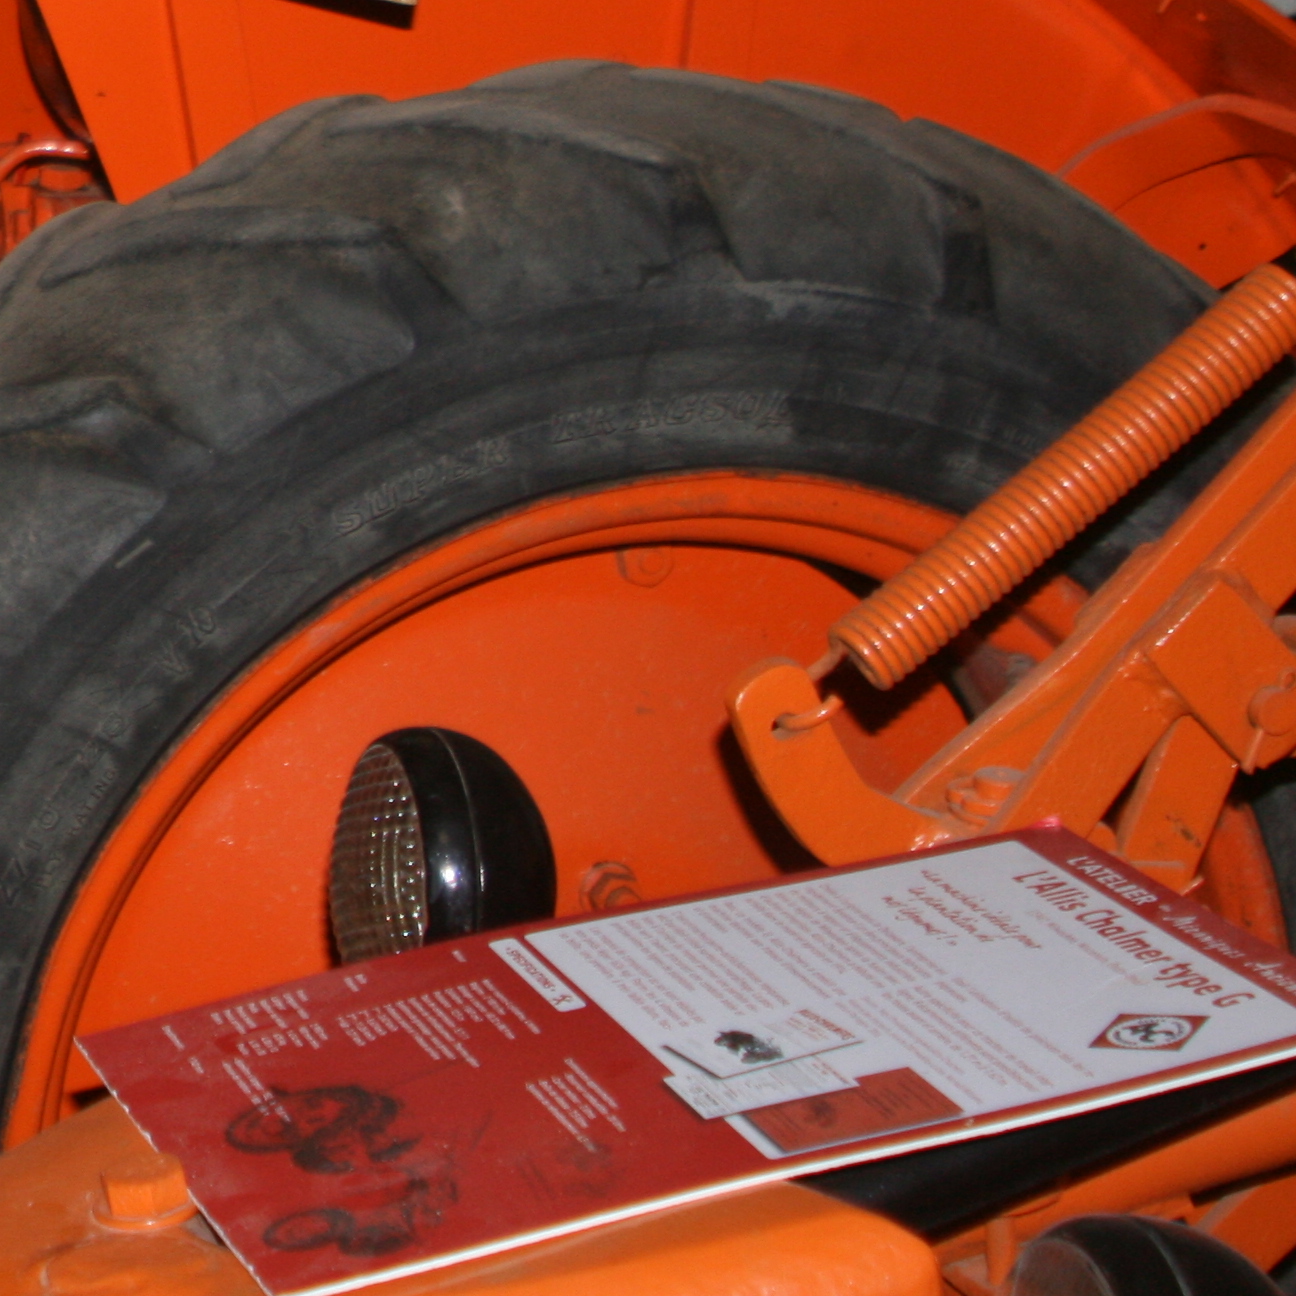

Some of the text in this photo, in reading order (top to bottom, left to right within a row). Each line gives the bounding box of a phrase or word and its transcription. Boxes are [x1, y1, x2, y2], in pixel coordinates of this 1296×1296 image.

[1068, 856, 1156, 905] L'ATELIER
[909, 896, 978, 934] plantation
[937, 883, 987, 912] machine
[997, 931, 1042, 949] pour
[1013, 870, 1088, 912] L'Allis
[1075, 909, 1172, 963] Chalmer
[1154, 962, 1222, 996] type
[1212, 992, 1256, 1008] G
